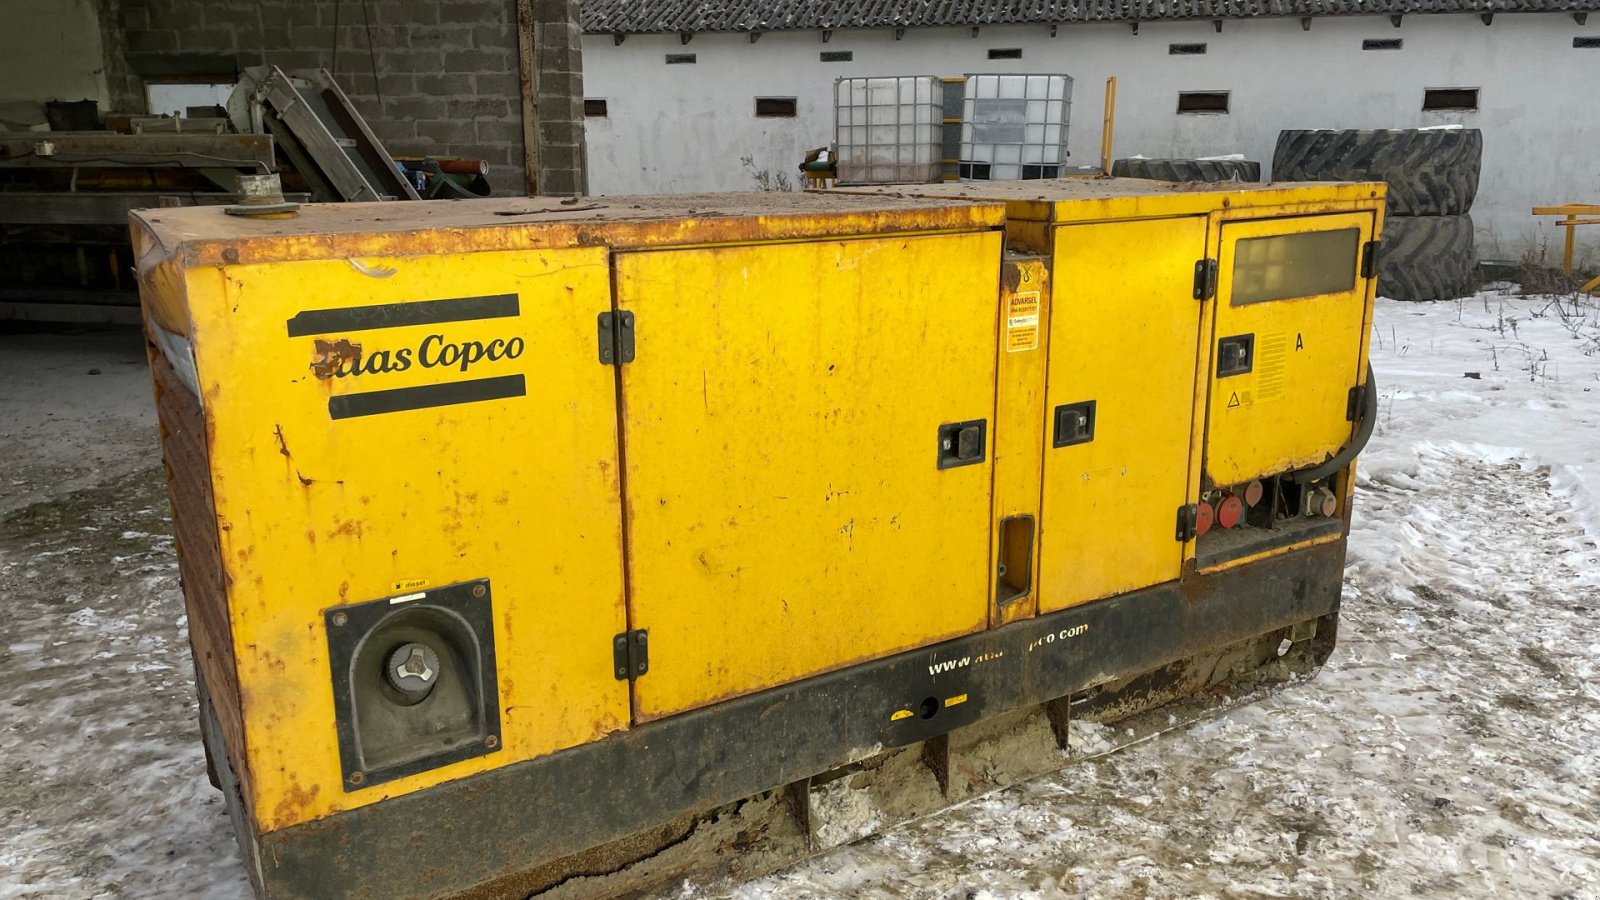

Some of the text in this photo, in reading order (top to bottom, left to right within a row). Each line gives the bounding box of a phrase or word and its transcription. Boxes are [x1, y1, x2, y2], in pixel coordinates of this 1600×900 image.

[1295, 332, 1304, 352] A
[418, 334, 525, 372] Copco
[405, 580, 425, 588] diesel
